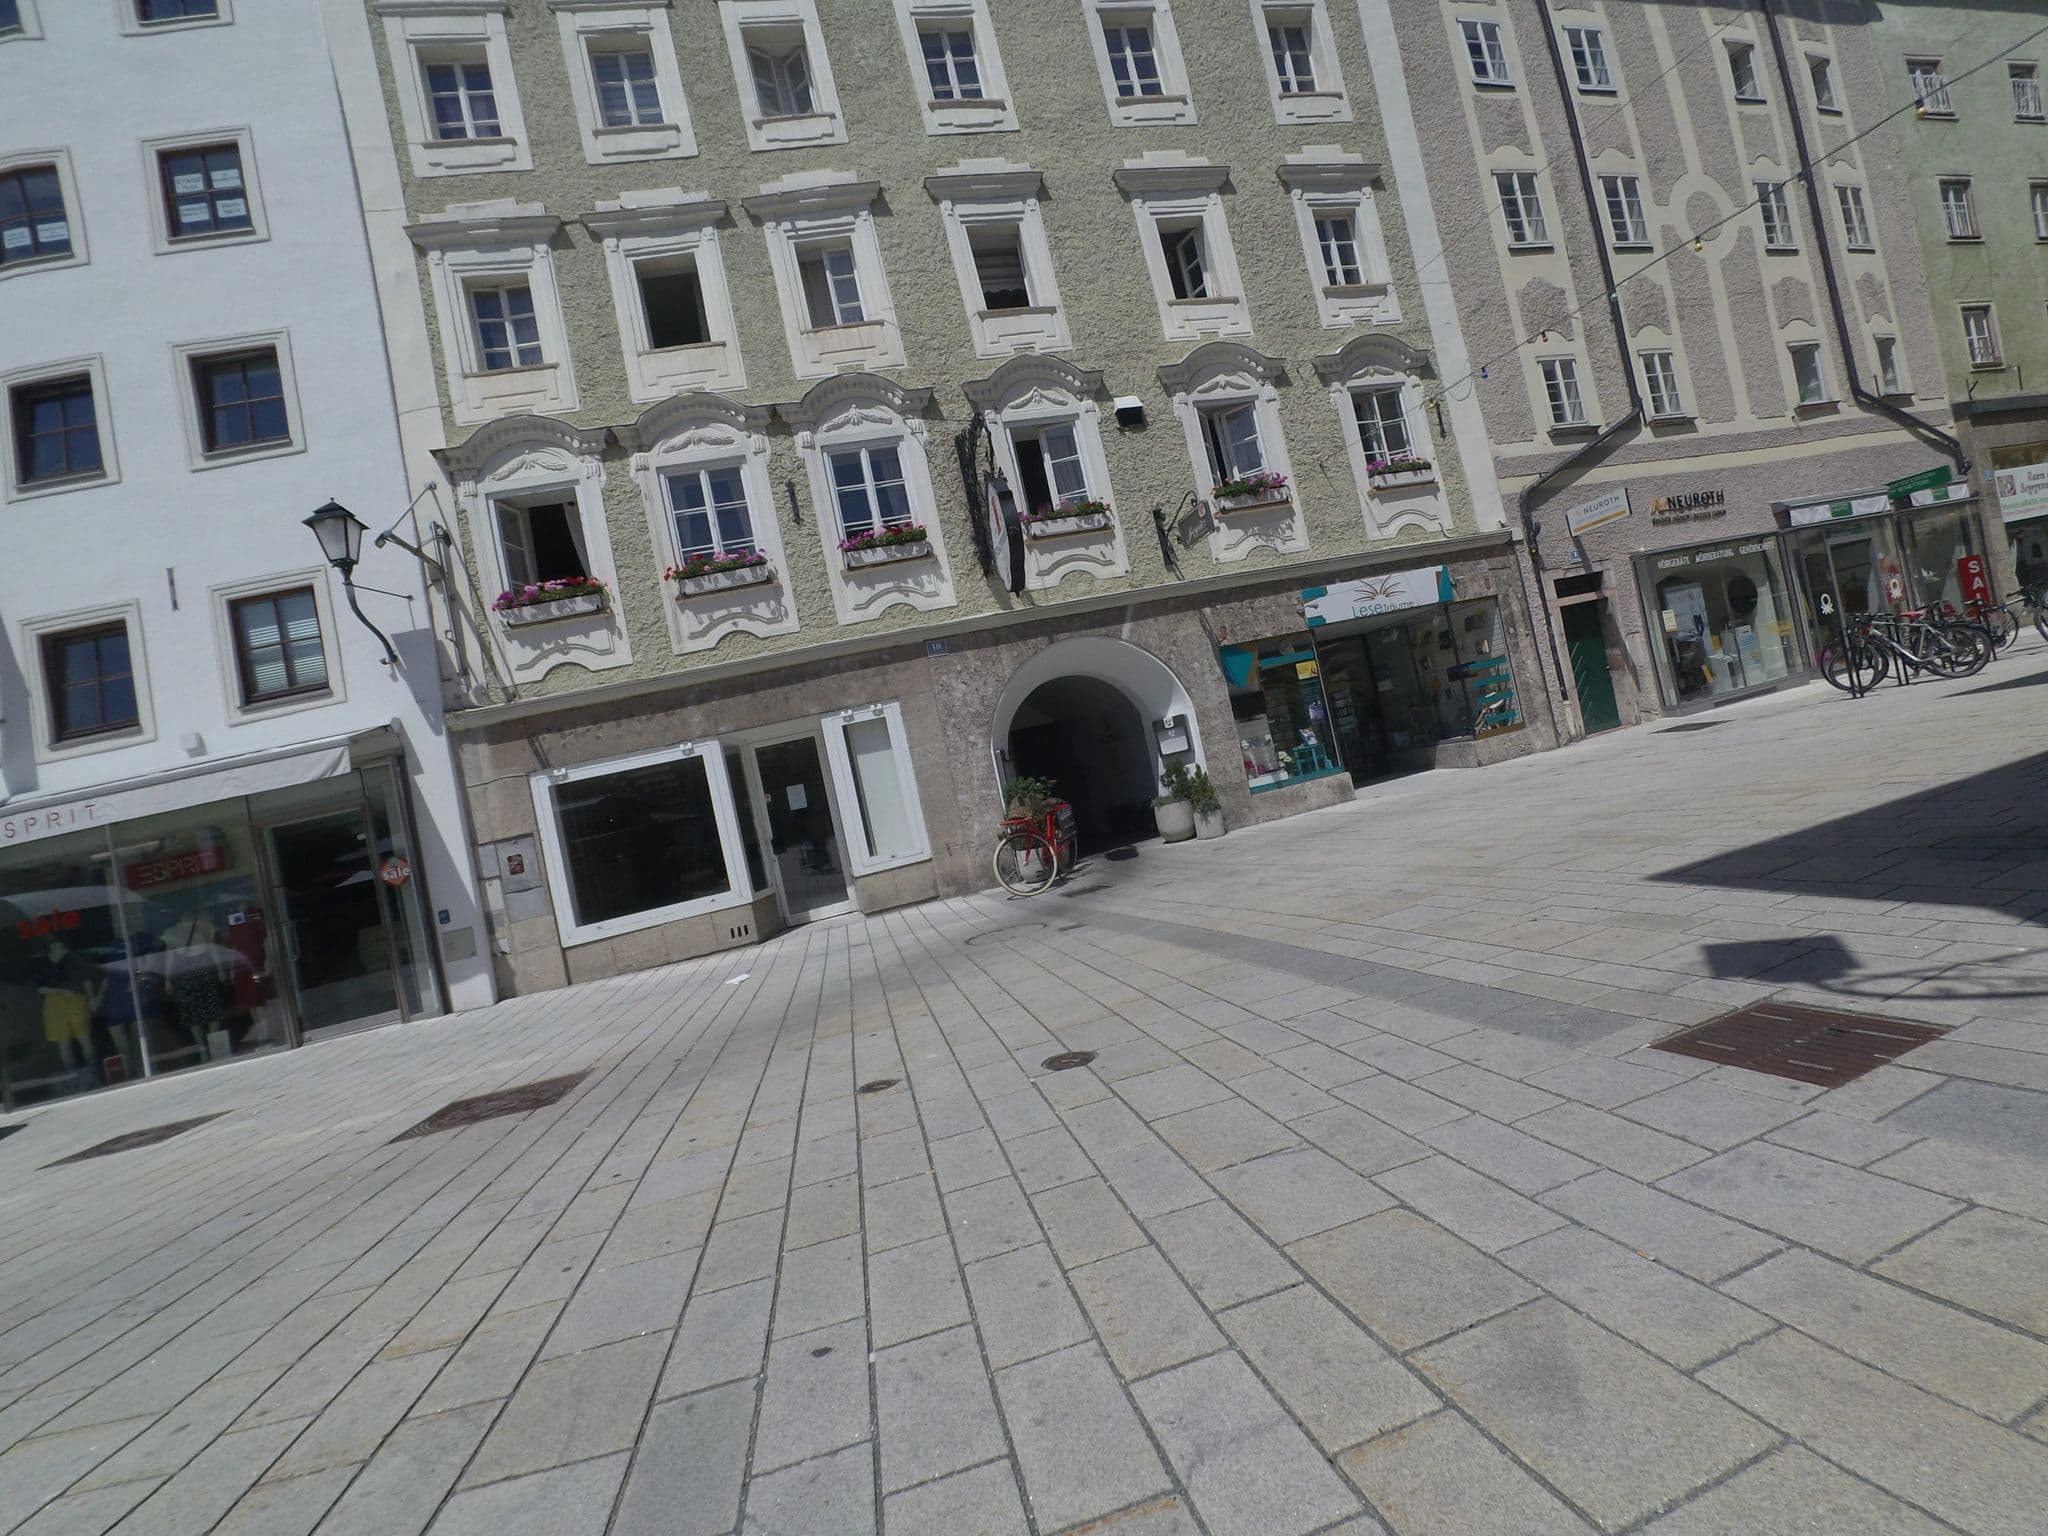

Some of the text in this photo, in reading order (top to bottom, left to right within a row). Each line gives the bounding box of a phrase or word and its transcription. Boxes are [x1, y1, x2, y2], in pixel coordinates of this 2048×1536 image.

[1583, 495, 1620, 514] NEUROTH
[1667, 490, 1725, 510] NEUROTH
[137, 852, 212, 885] ESPRIT
[383, 866, 411, 881] sale
[16, 908, 81, 940] sale
